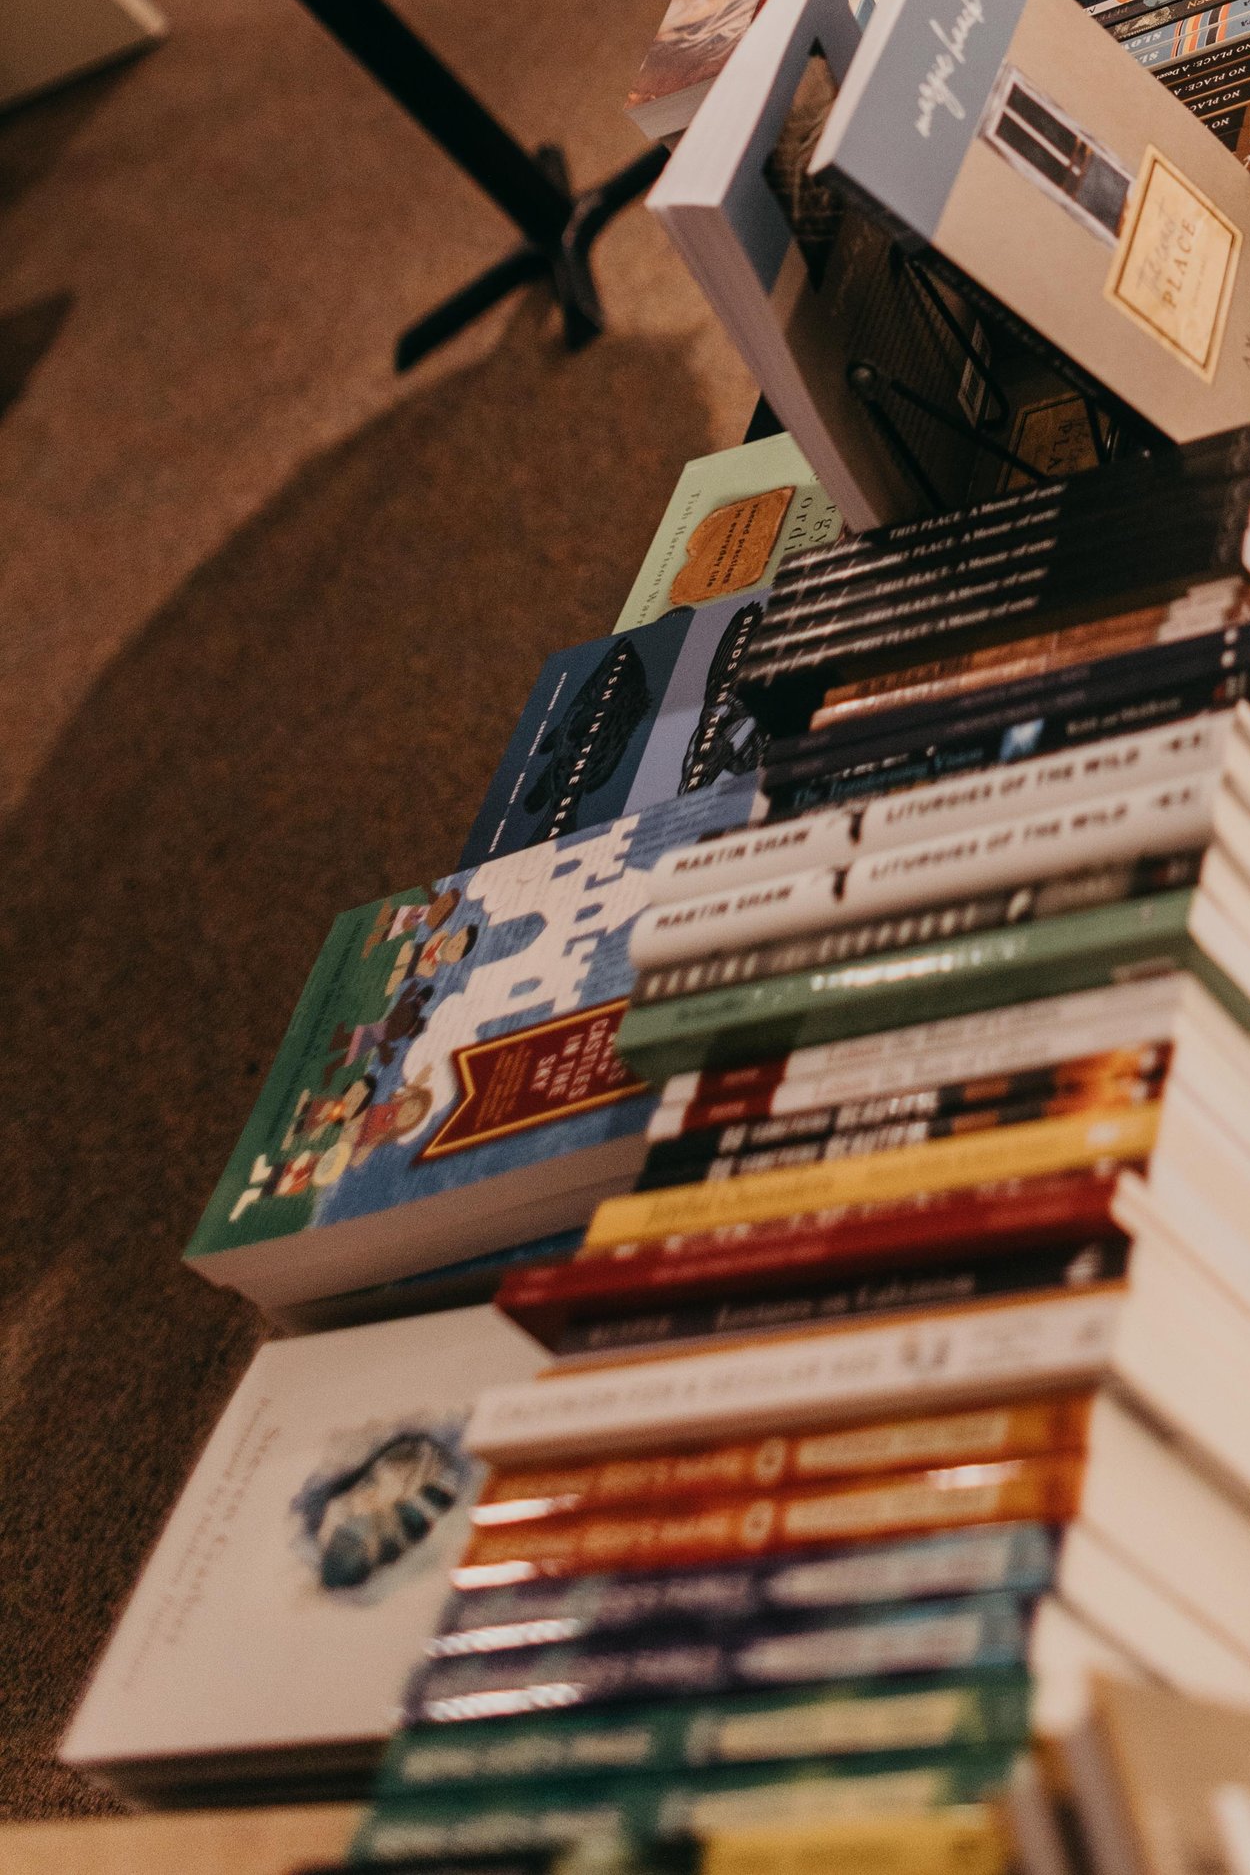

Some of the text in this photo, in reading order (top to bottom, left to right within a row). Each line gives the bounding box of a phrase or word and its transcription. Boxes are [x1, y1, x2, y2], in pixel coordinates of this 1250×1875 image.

[1178, 64, 1189, 73] A
[1183, 72, 1225, 92] PLACE:
[1190, 48, 1232, 69] PLACE:
[1225, 64, 1247, 78] NO
[1186, 88, 1241, 113] NO PLAC
[1209, 116, 1230, 129] NO
[1162, 218, 1196, 309] PLACE
[687, 616, 753, 789] BIRDS IN THE SK
[549, 653, 628, 838] FISH IN THE SEA
[880, 743, 1143, 826] LITURGIES OF THE WILD
[669, 825, 815, 876] MARTIN SHAW
[866, 802, 1130, 883] LITURGIES OF THE WILD
[650, 882, 797, 933] MARTIN SHAW
